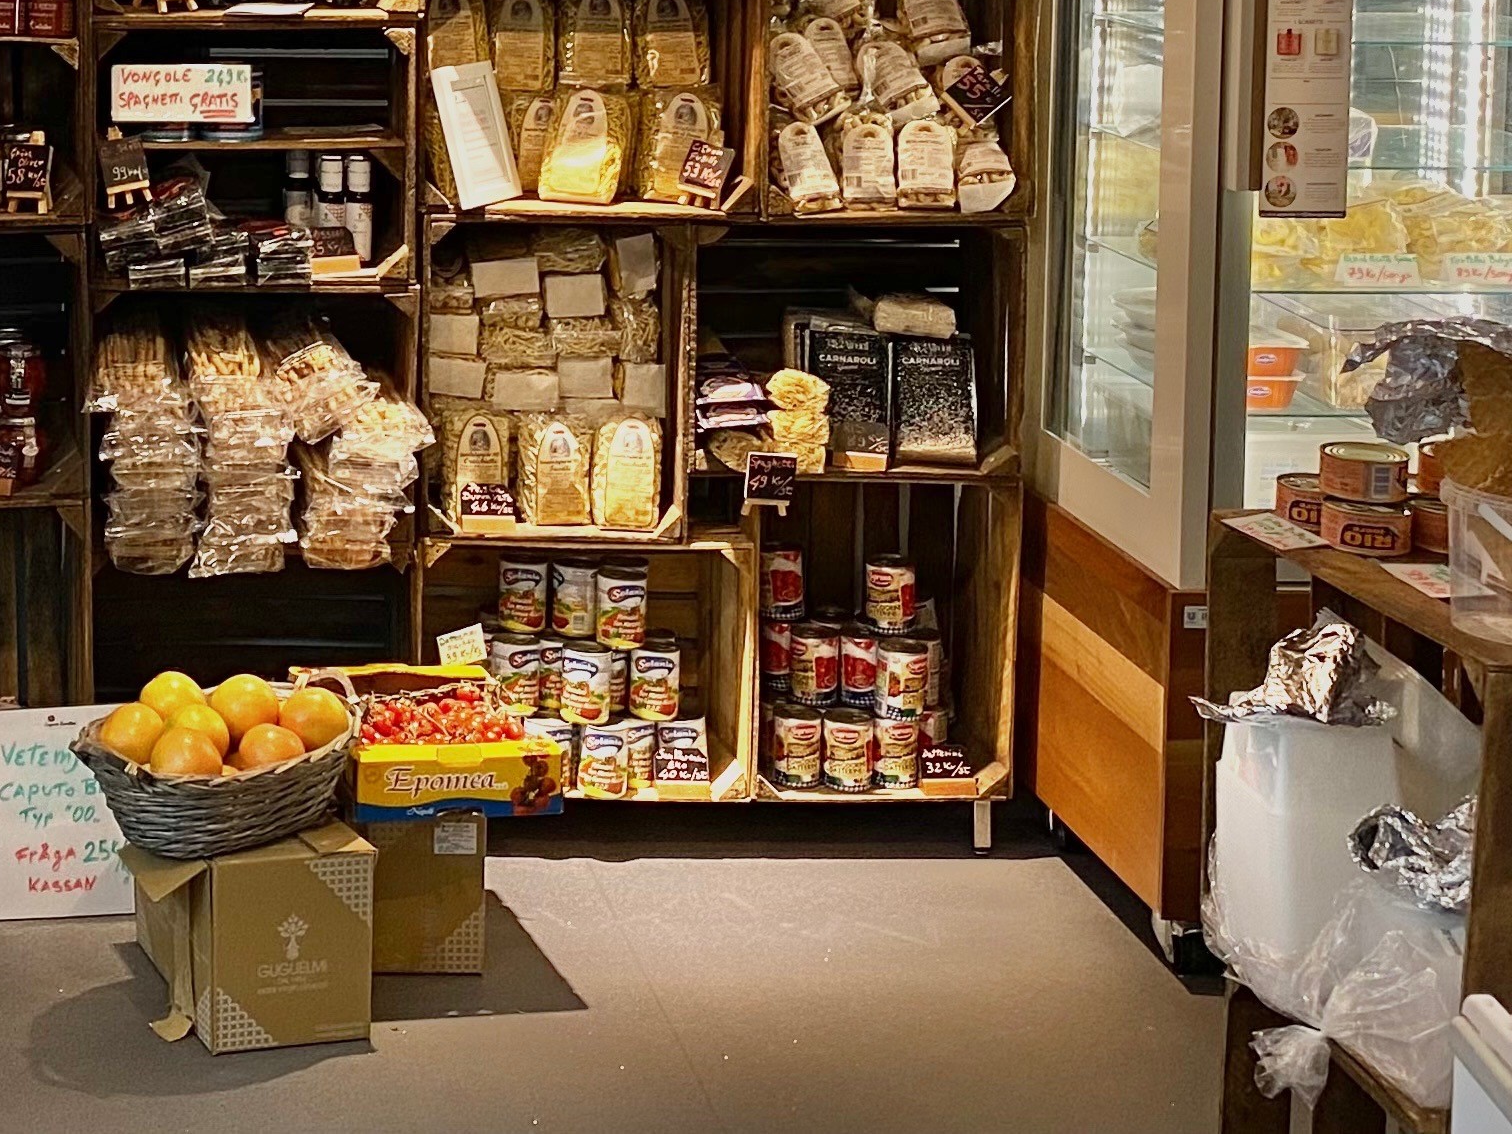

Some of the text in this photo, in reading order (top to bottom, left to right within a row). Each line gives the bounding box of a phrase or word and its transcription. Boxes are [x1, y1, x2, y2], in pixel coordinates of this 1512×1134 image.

[819, 354, 876, 365] CARNAROLI
[902, 357, 960, 366] CARNAROLI
[1343, 531, 1392, 548] RIO
[385, 765, 496, 800] Epomea
[29, 876, 97, 894] KASSAN
